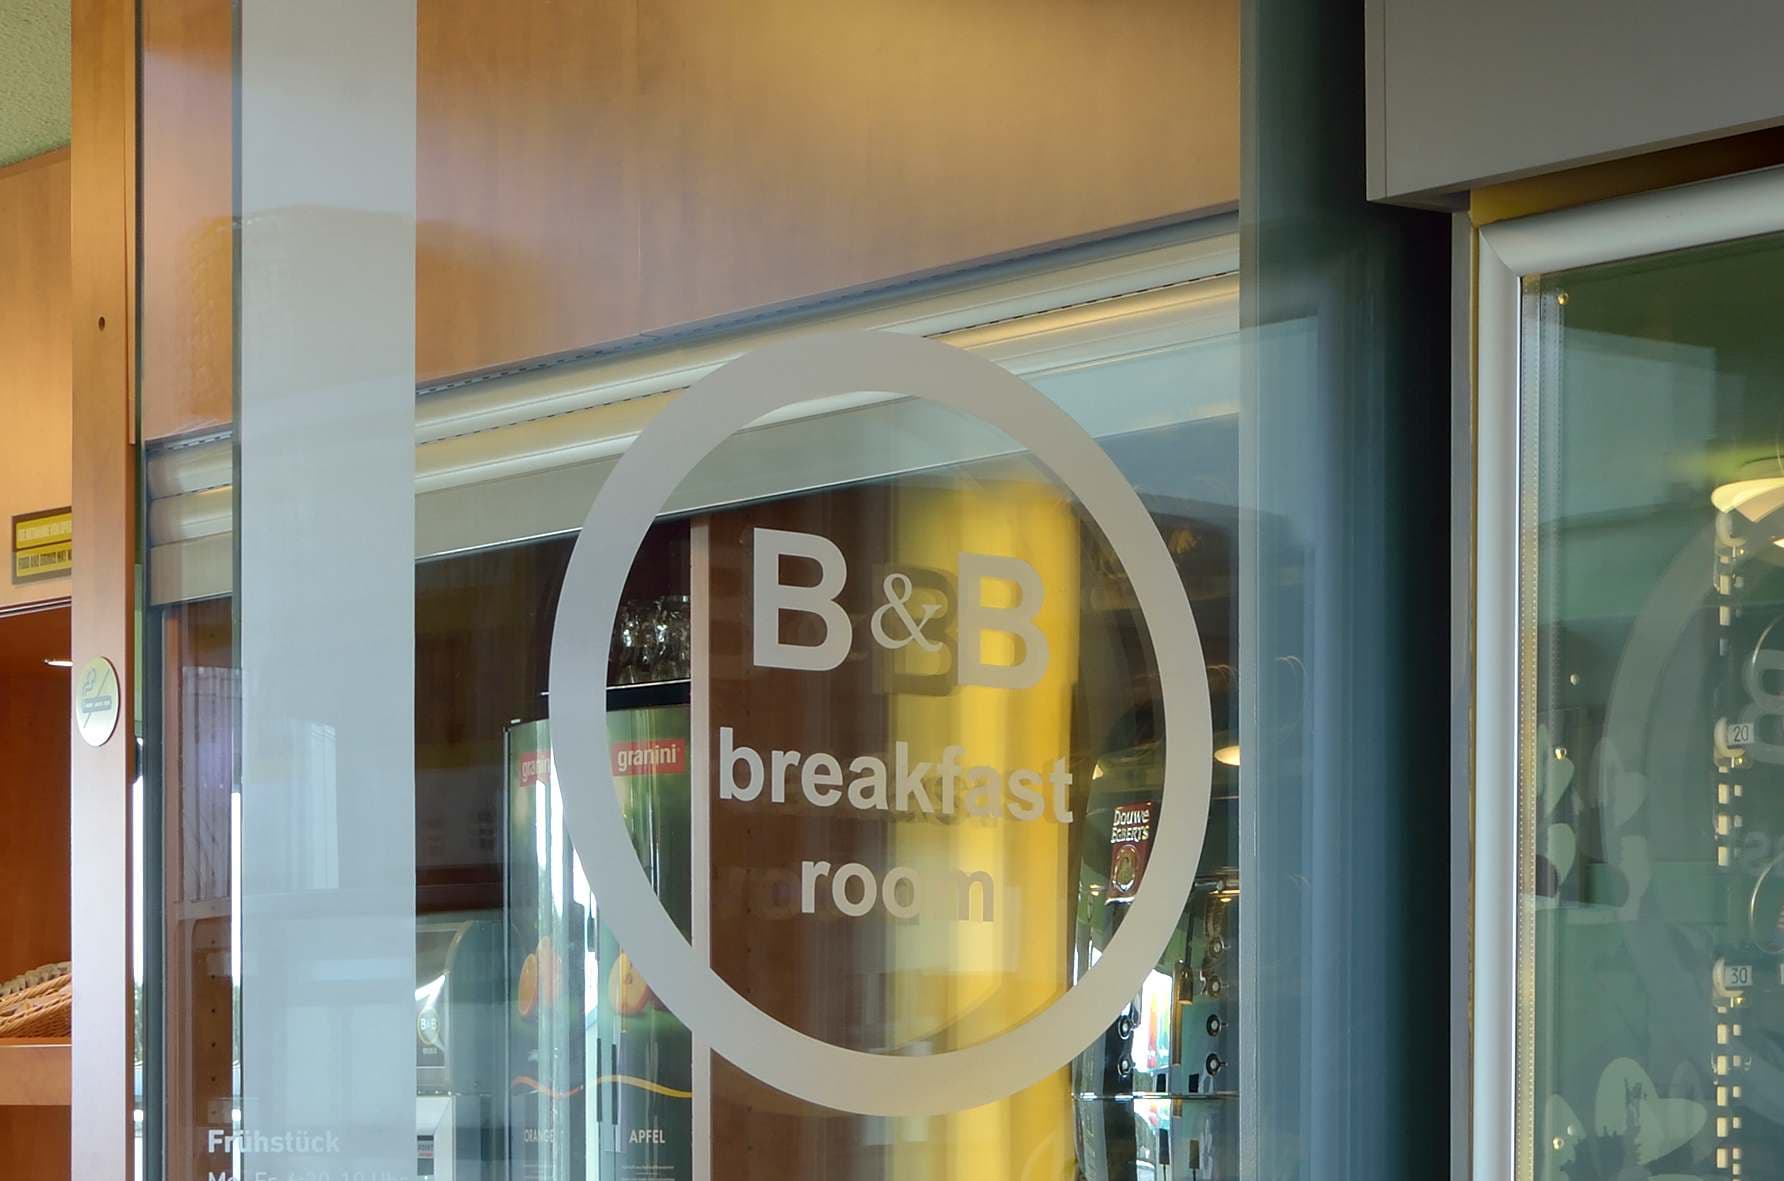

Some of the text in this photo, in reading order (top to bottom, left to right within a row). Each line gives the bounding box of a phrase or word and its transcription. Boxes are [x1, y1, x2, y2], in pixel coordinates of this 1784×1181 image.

[1733, 725, 1751, 742] 20
[617, 743, 677, 770] granini
[719, 726, 1074, 824] breakfast
[1114, 806, 1151, 825] Douwe
[800, 860, 995, 923] room
[1731, 966, 1749, 984] 30
[208, 1129, 341, 1153] Frühstück
[629, 1129, 666, 1143] APFEL
